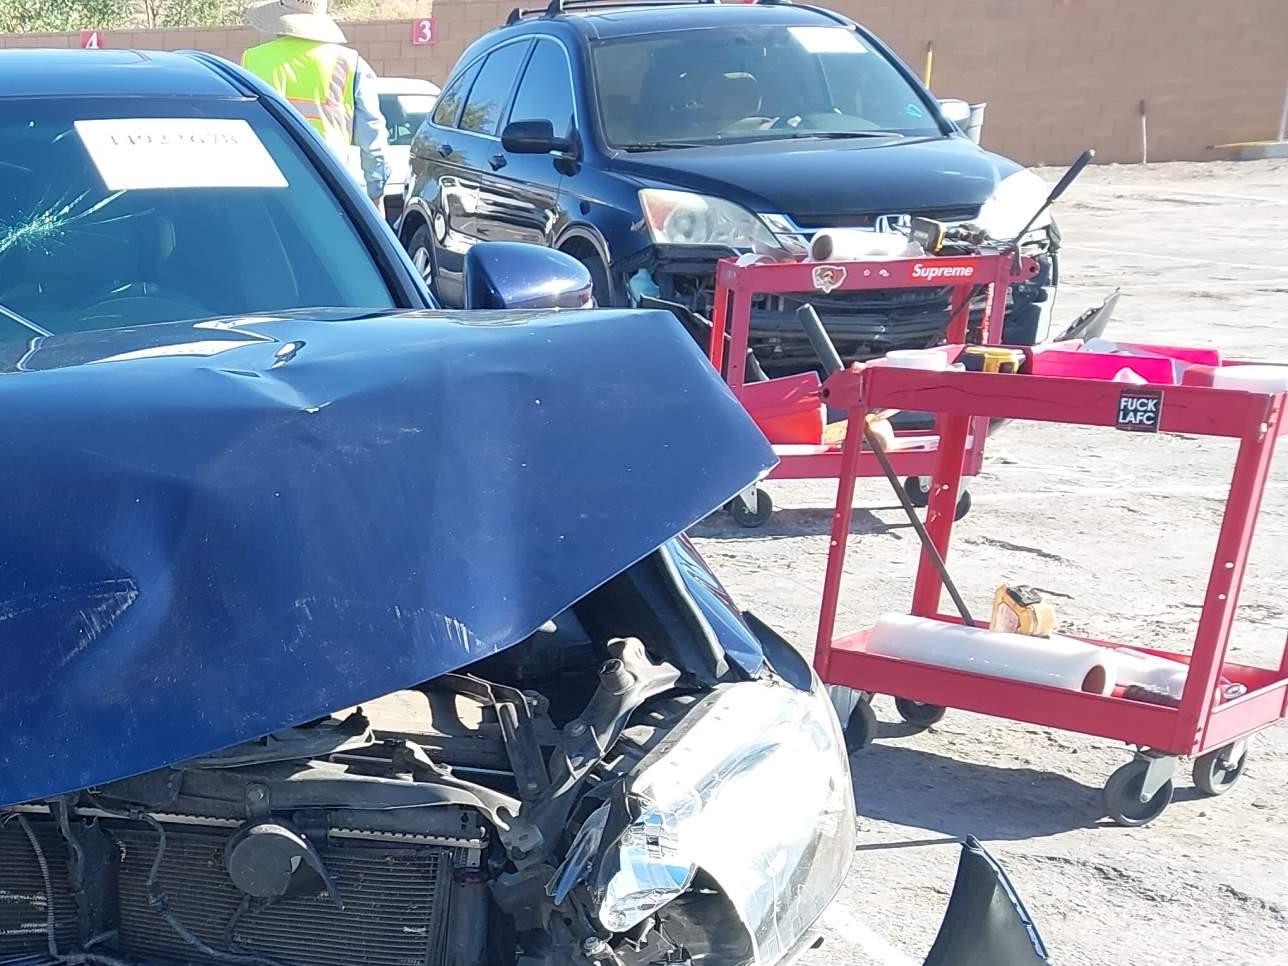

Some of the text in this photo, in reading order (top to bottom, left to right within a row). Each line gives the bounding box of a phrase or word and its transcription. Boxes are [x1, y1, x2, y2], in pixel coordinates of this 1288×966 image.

[85, 31, 99, 49] 4
[418, 20, 432, 42] 3
[912, 263, 974, 281] Supreme
[1120, 397, 1158, 411] FUCK
[1118, 410, 1155, 425] LAFC
